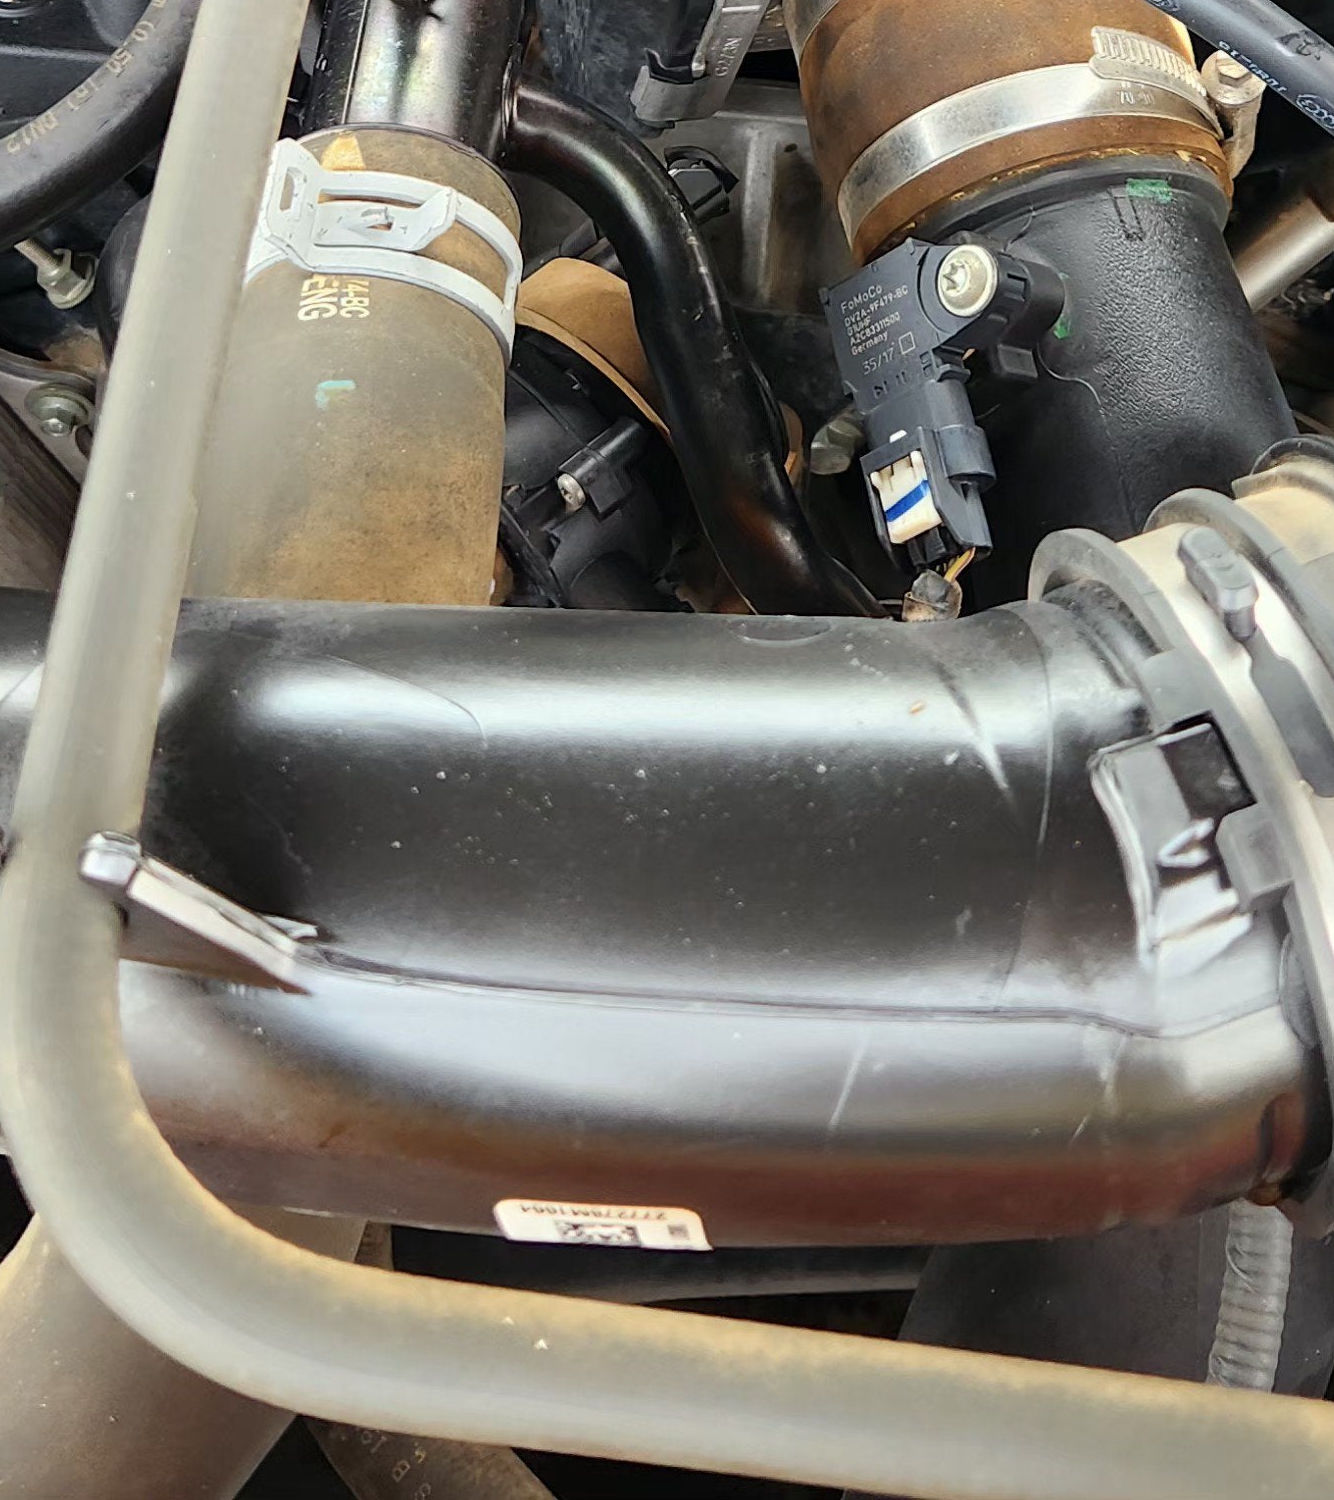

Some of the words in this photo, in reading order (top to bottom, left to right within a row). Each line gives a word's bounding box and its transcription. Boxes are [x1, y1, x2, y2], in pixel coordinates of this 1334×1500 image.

[840, 285, 882, 314] FoMoCo
[851, 331, 888, 356] Germany
[861, 348, 894, 376] 35/17
